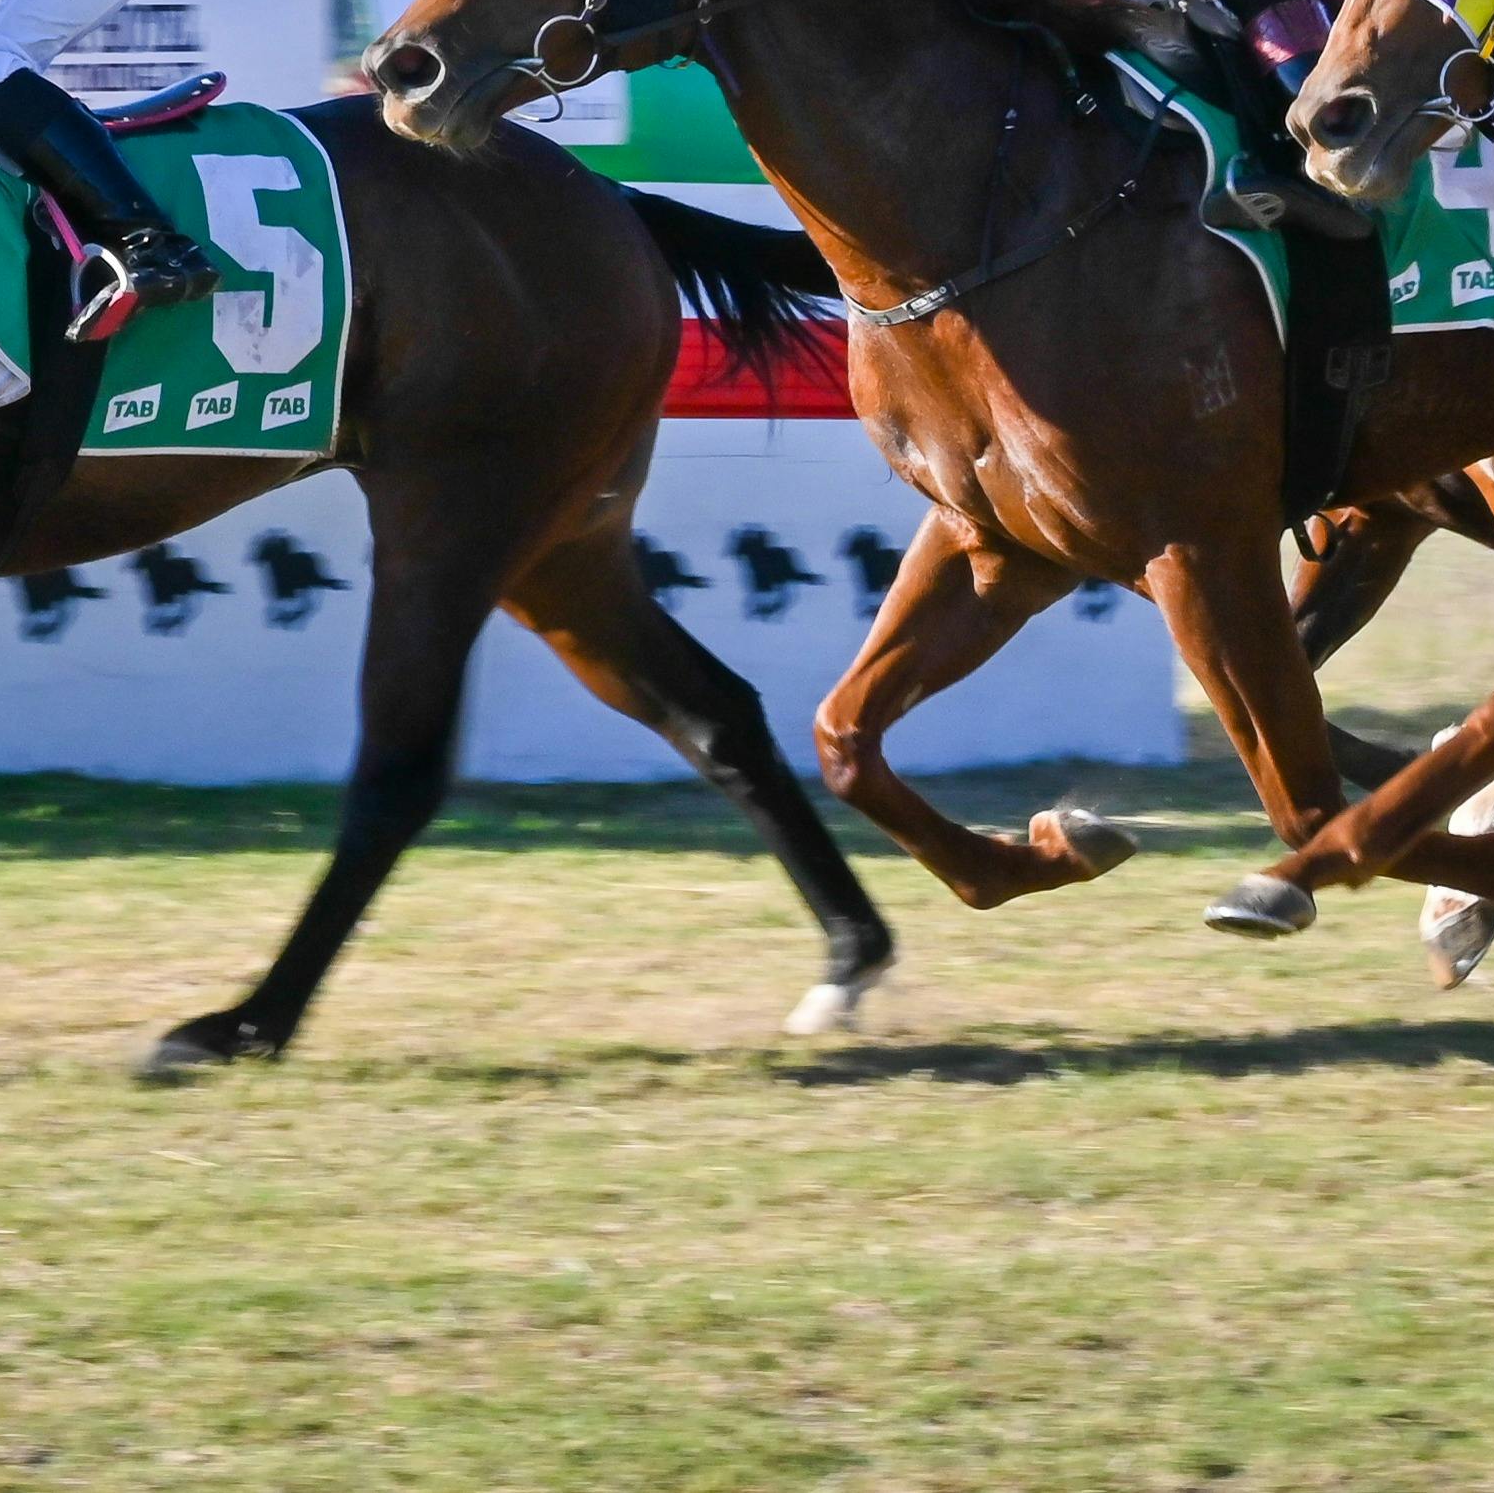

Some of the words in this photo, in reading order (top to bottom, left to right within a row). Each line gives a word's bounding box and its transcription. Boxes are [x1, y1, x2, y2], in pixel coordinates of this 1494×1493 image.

[191, 153, 324, 374] 5
[112, 400, 155, 419] TAB
[195, 396, 233, 416] TAB
[268, 396, 306, 416] TAB
